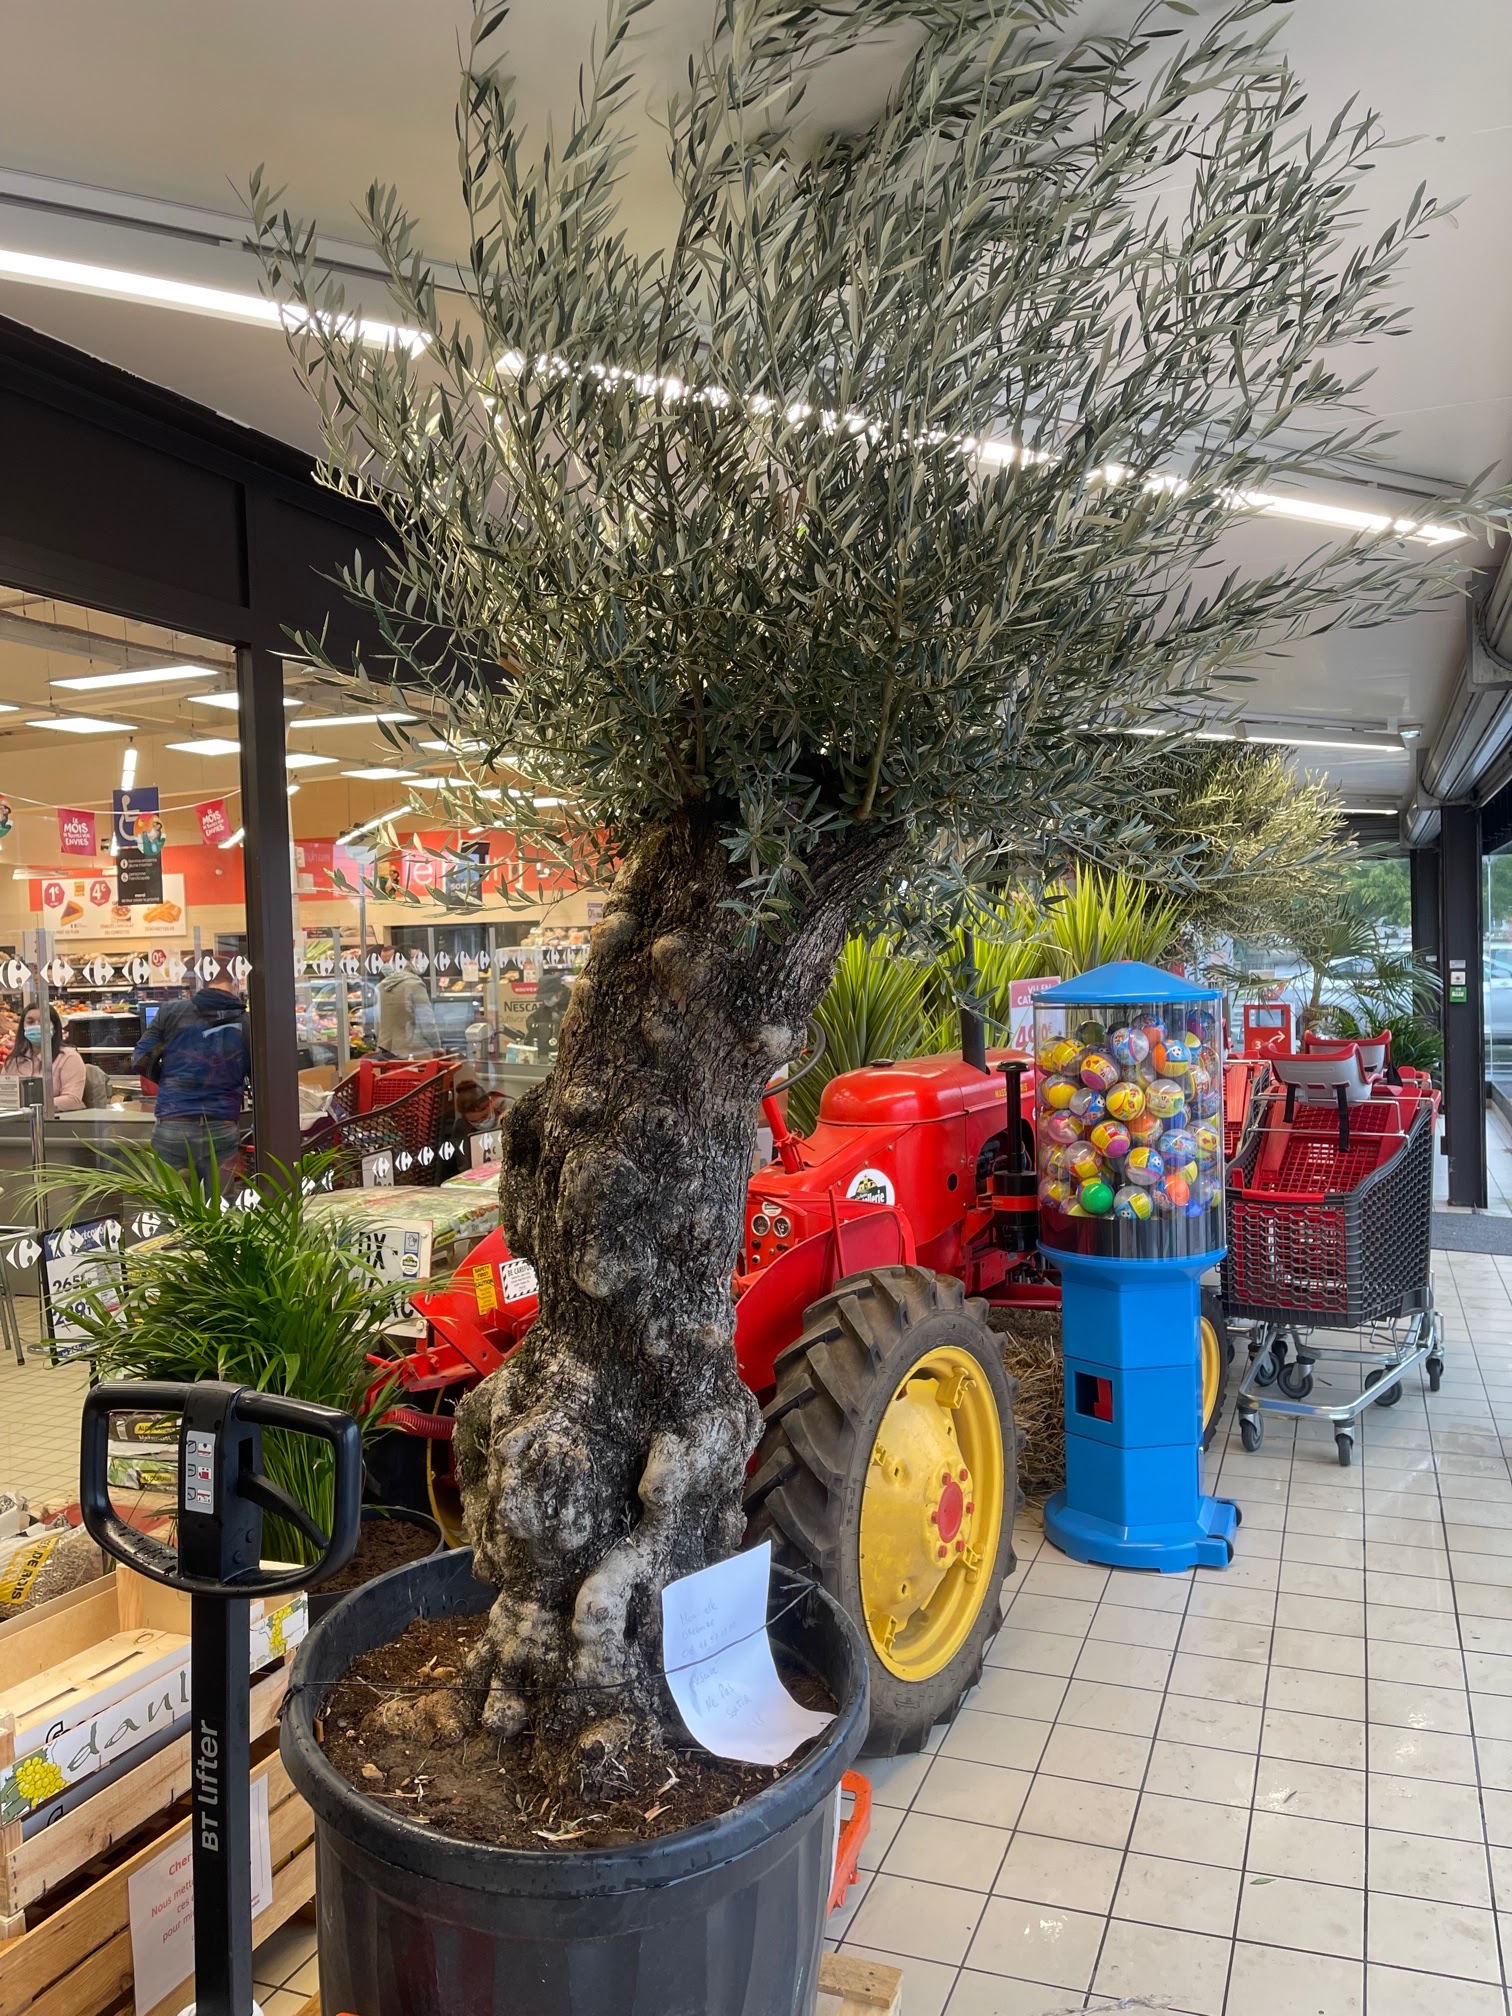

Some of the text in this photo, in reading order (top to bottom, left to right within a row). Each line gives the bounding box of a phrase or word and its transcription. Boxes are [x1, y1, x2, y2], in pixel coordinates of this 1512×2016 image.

[202, 810, 221, 826] MOIS
[63, 822, 88, 834] MOIS
[65, 838, 89, 846] ENVIES
[1255, 1040, 1261, 1050] 3
[201, 1811, 219, 1852] BT
[168, 1853, 193, 1876] Cher
[151, 1894, 172, 1918] Nous
[176, 1899, 190, 1914] ces
[162, 1919, 181, 1944] pour
